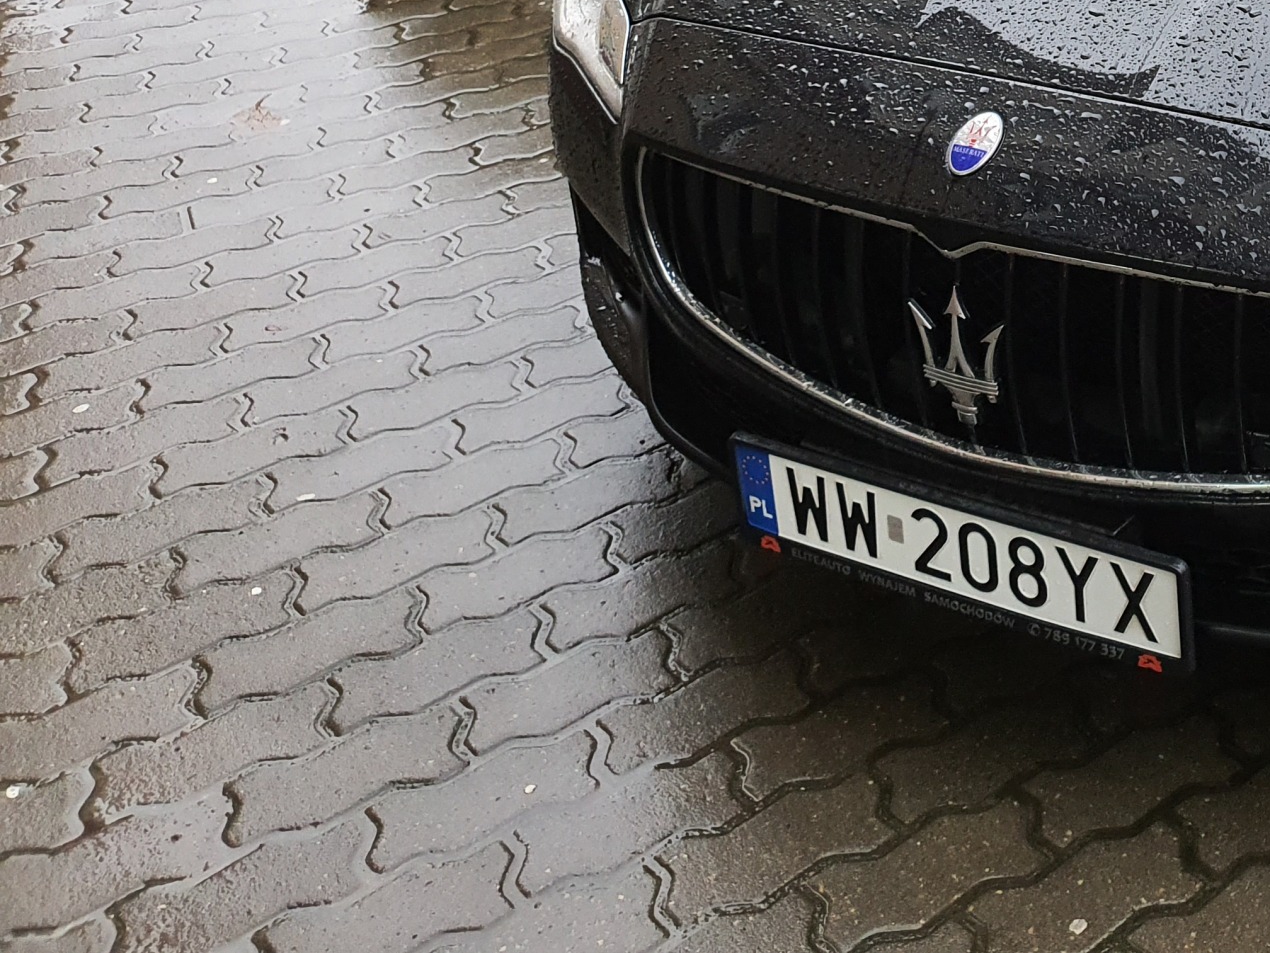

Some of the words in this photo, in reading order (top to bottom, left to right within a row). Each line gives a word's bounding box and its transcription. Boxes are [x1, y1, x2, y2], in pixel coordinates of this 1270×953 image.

[748, 494, 774, 521] PL
[785, 465, 880, 559] WW
[910, 506, 1160, 644] 208YX
[858, 568, 917, 598] WYNAJEM
